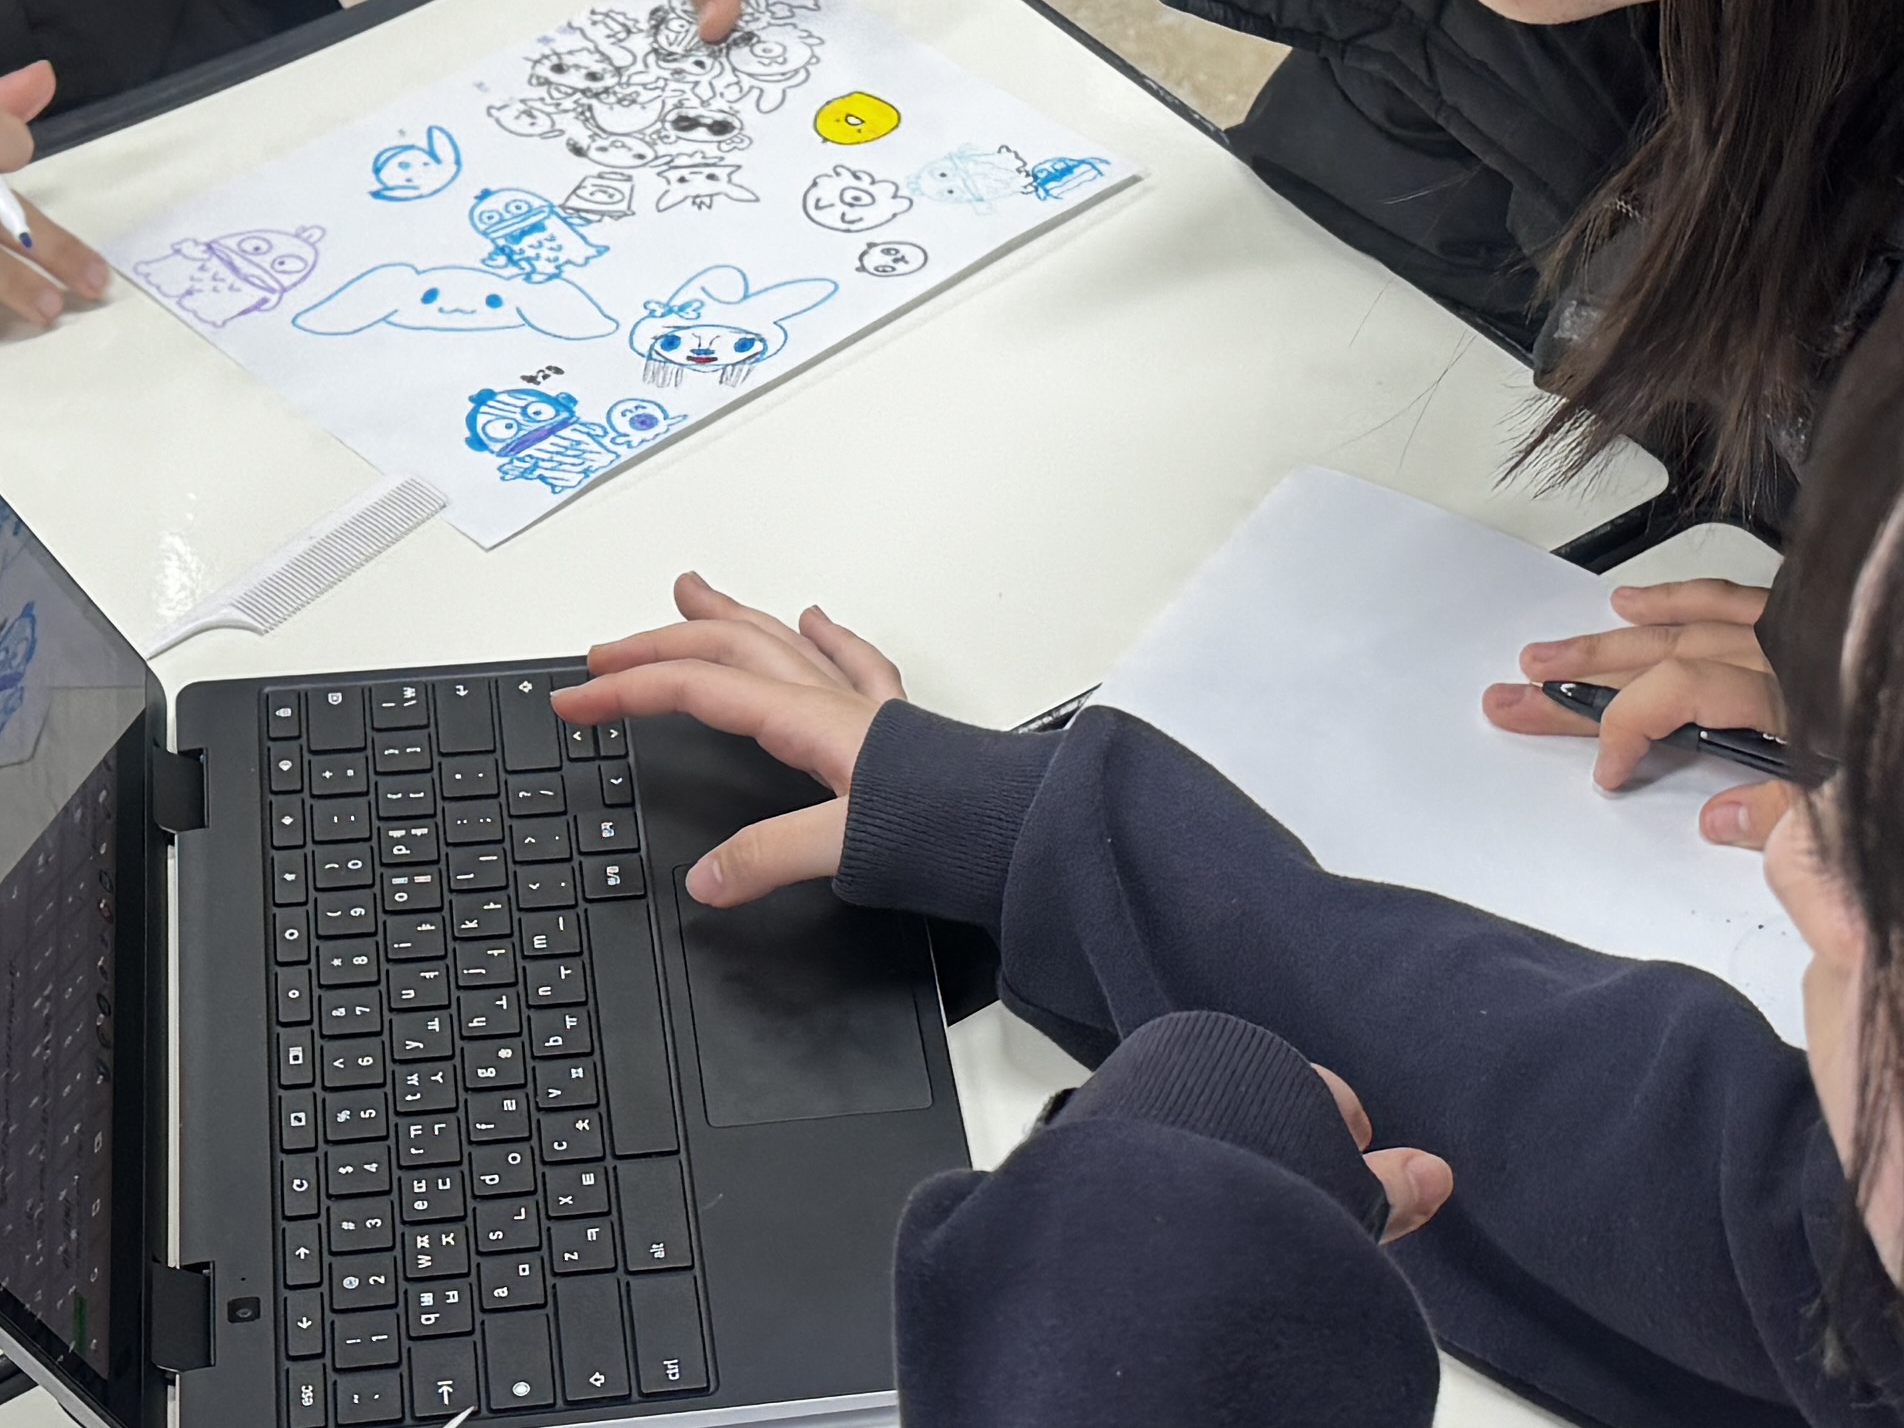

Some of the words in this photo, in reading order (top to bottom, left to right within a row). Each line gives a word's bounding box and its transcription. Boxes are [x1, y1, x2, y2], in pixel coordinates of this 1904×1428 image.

[649, 1242, 665, 1259] alt
[662, 1359, 680, 1381] ctrl
[300, 1384, 314, 1407] esc
